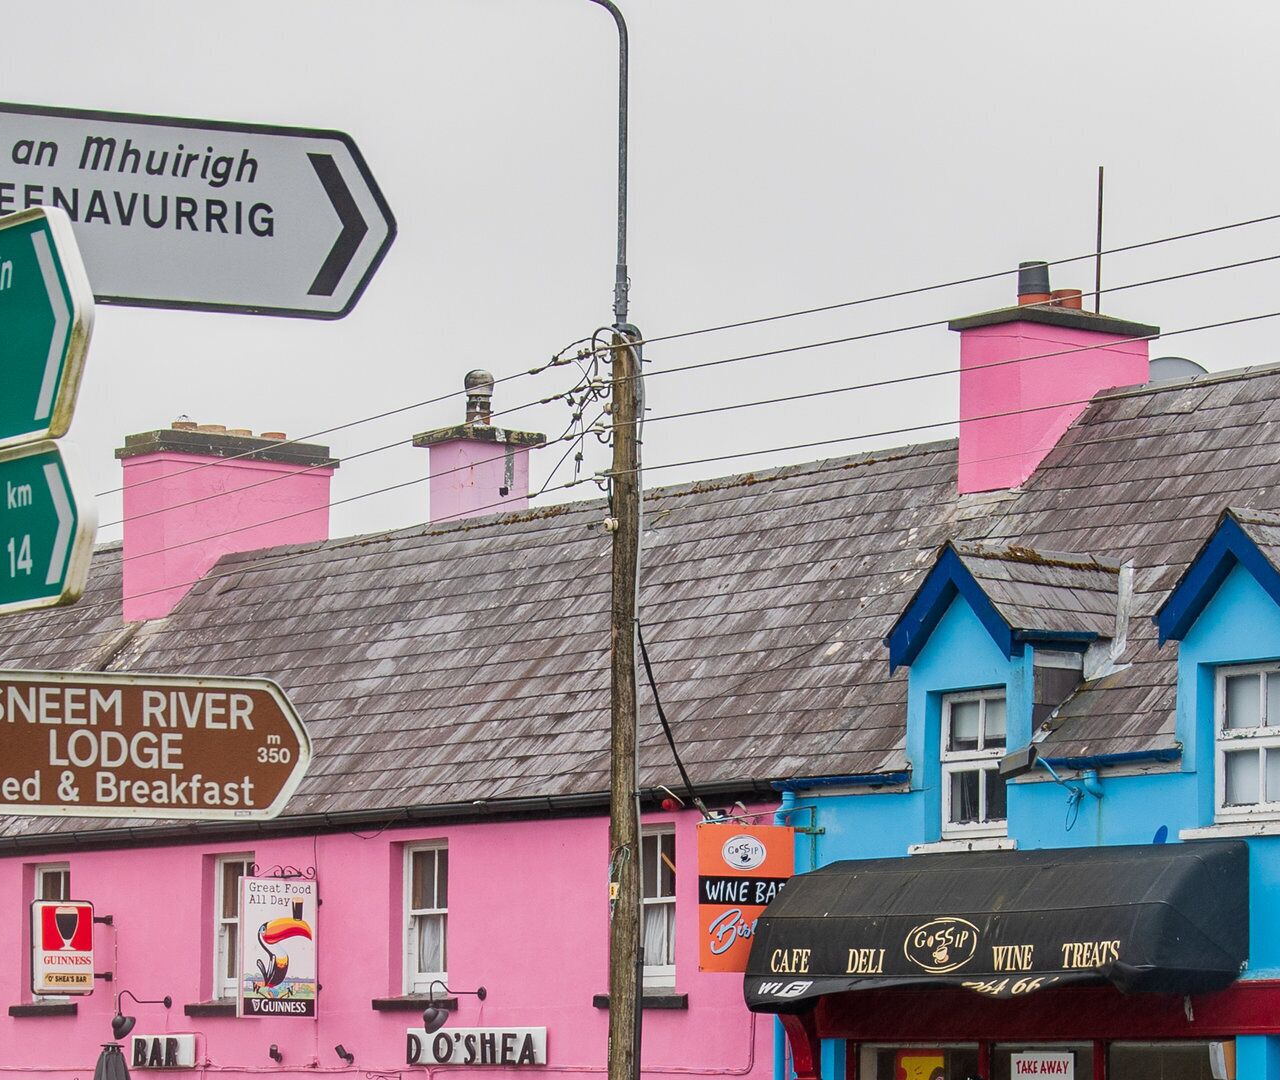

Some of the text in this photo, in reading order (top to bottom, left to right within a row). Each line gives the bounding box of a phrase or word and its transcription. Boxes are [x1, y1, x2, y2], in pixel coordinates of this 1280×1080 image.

[11, 140, 57, 167] an
[79, 135, 259, 188] Mhuirigh
[7, 481, 32, 509] km
[7, 534, 33, 578] 14
[143, 691, 254, 730] RIVER
[49, 730, 281, 770] LODGE m
[257, 747, 291, 764] 350
[58, 772, 79, 802] &
[95, 772, 254, 806] Breakfast
[249, 882, 311, 894] Great Food
[249, 895, 290, 907] All Day
[706, 881, 749, 902] WINE
[44, 956, 91, 965] GUINNESS
[771, 949, 811, 973] CAFE
[847, 948, 886, 974] DELI
[992, 945, 1034, 971] WINE
[1061, 940, 1121, 968] TREATS
[261, 999, 306, 1013] GUINNESS
[134, 1037, 177, 1067] BAR
[408, 1031, 536, 1066] D O'SHEA
[1016, 1060, 1069, 1074] TAKE AWAY
